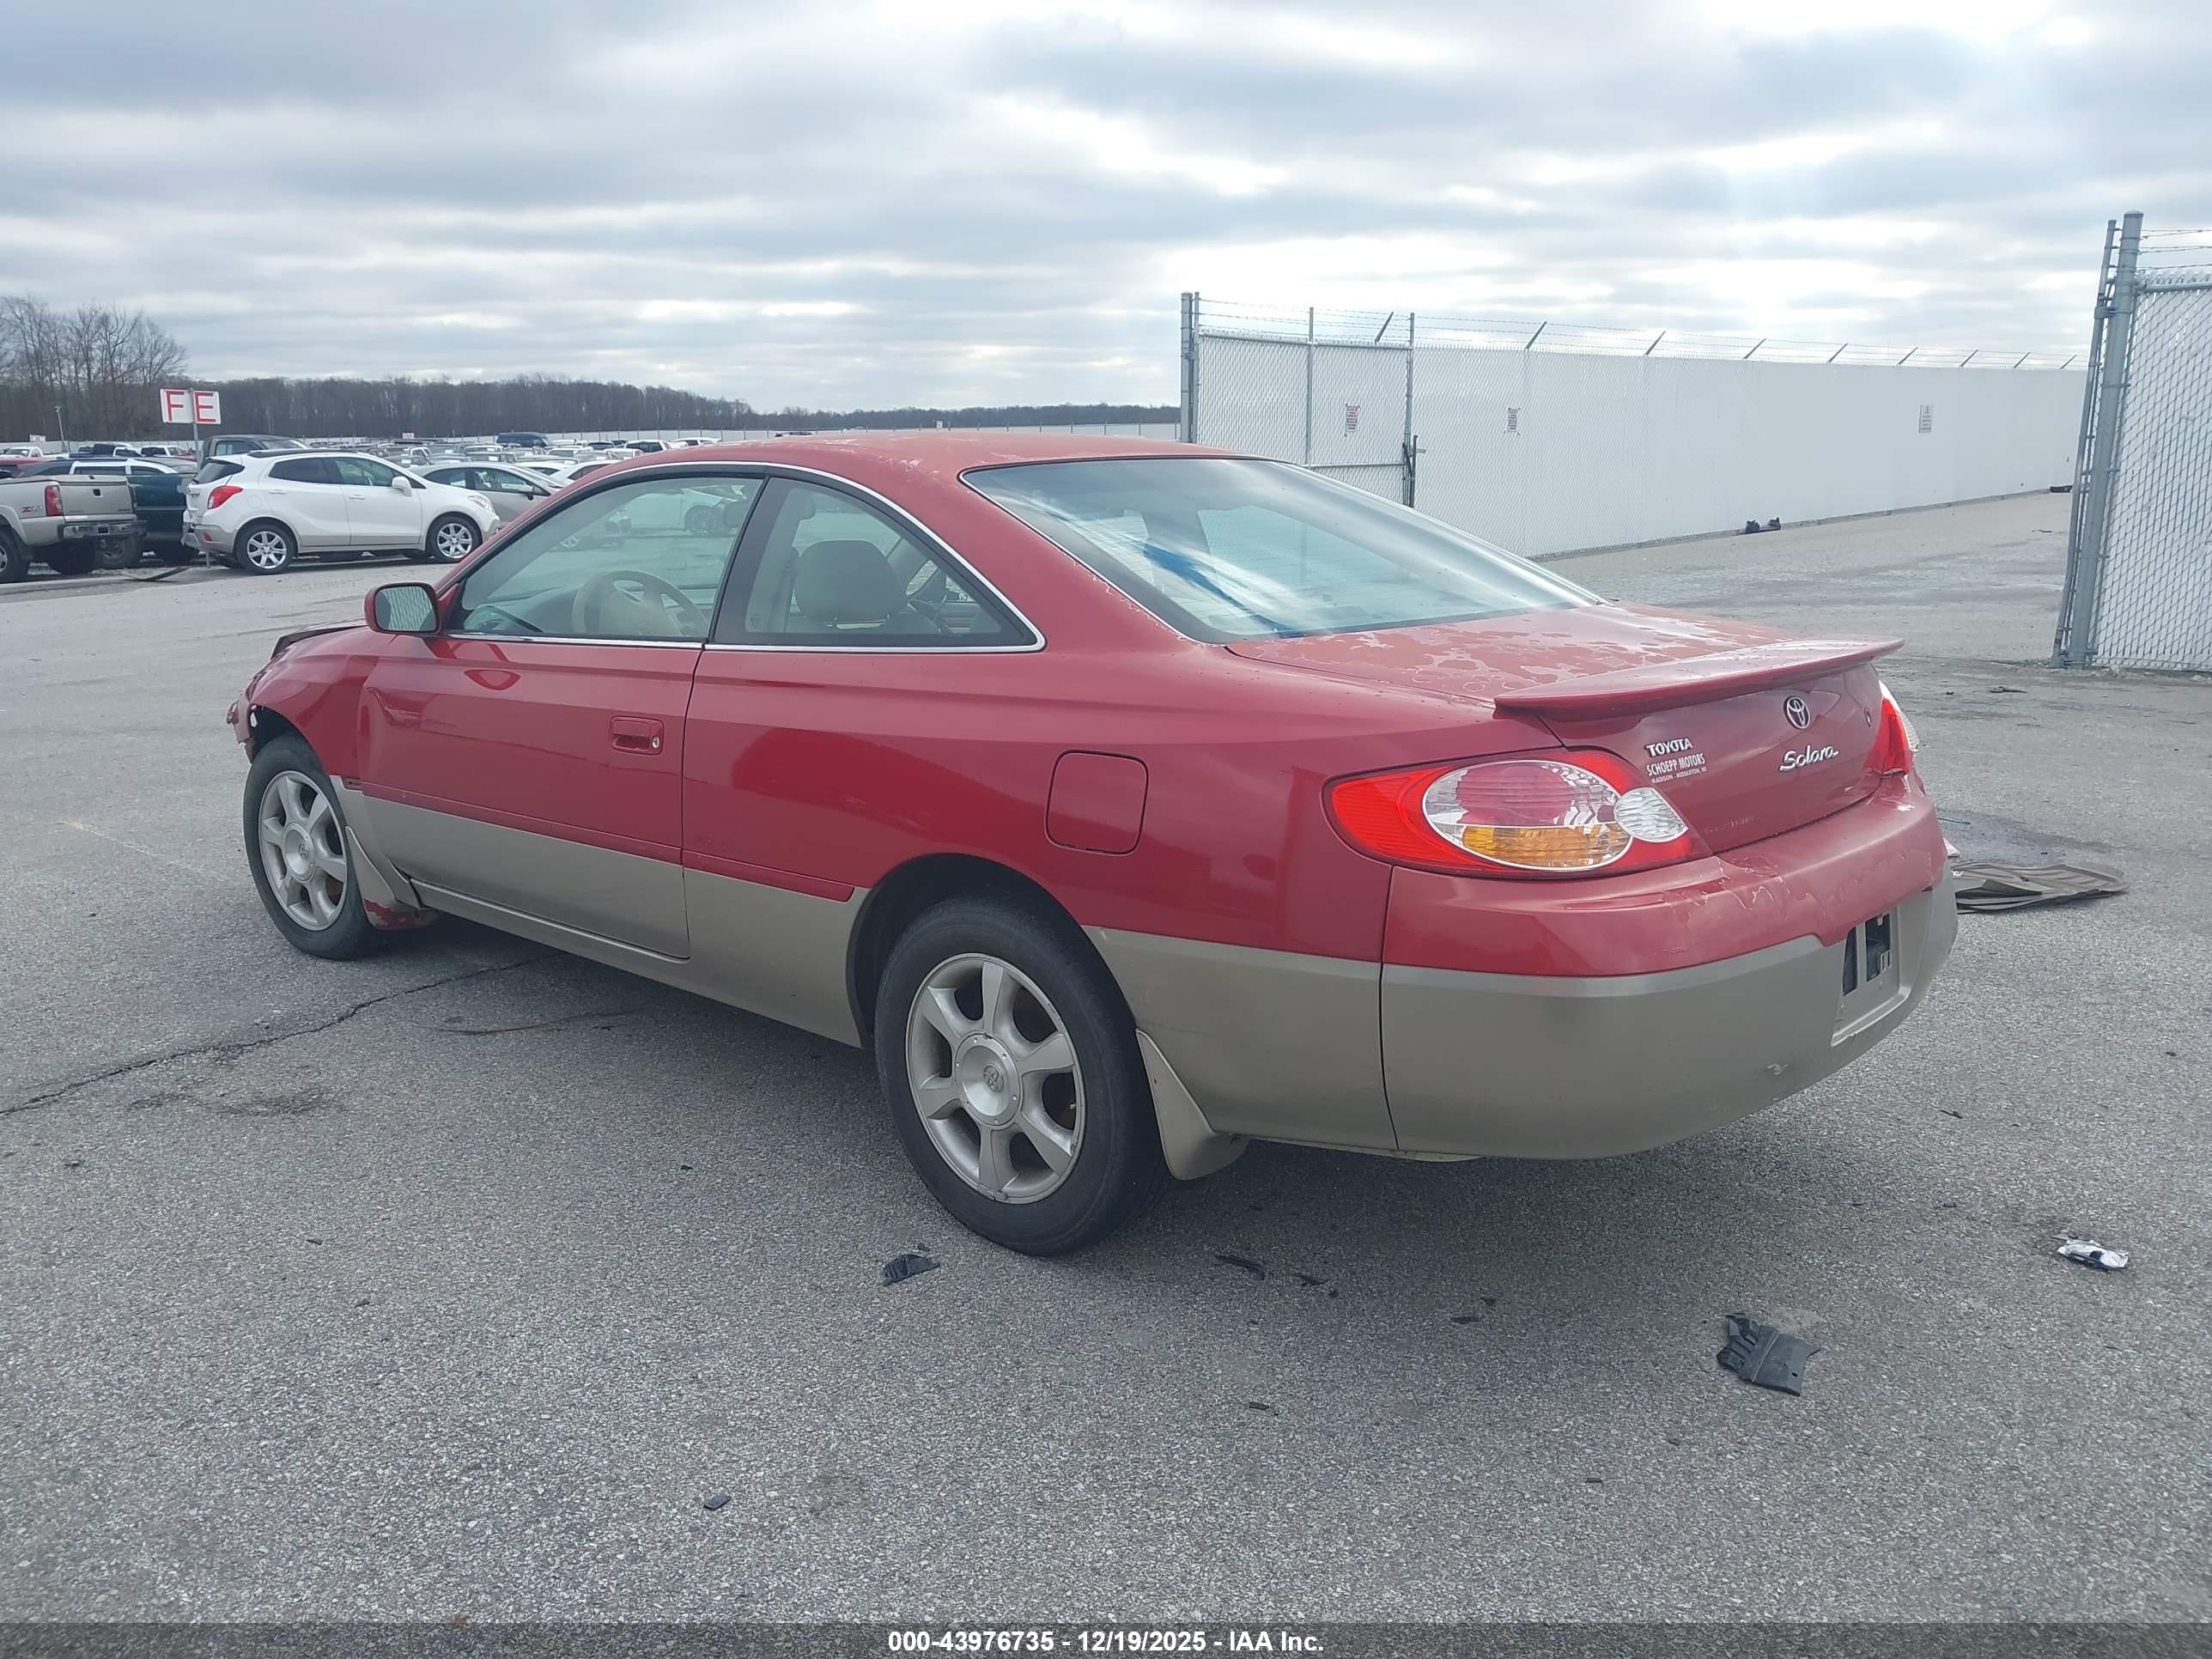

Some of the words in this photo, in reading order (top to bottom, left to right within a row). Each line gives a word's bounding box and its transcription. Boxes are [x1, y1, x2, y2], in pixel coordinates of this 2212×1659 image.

[1645, 738, 1693, 757] TOYOTA
[1778, 744, 1839, 771] Solara
[1646, 758, 1677, 777] SCHOEPP
[1678, 753, 1705, 769] MOTORS
